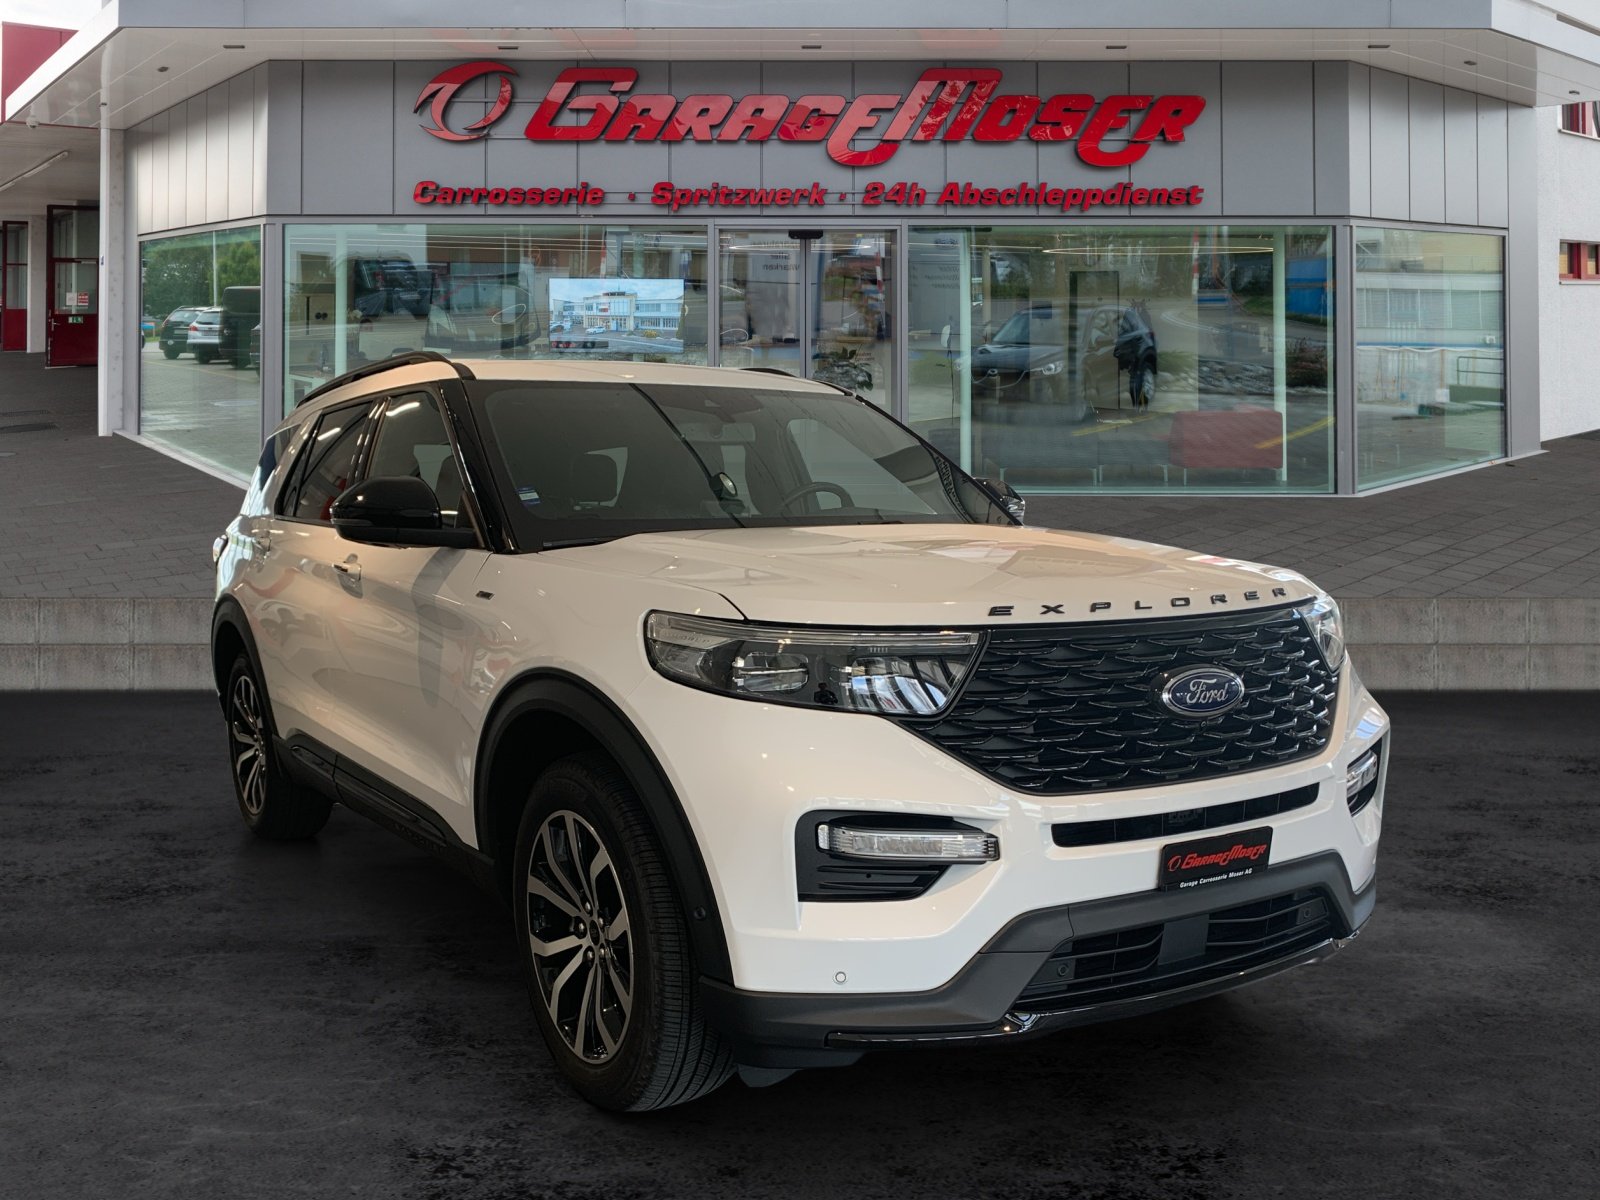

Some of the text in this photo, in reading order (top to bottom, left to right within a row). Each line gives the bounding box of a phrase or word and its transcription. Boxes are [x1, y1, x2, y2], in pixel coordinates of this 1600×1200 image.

[412, 180, 1204, 212] Carrosserie Spritzwerk 24h Abschleppdienst
[988, 587, 1288, 617] EXPLORER
[1186, 678, 1229, 705] Ford
[1180, 880, 1198, 888] Garage
[1199, 874, 1227, 884] Carrosserie
[1228, 870, 1244, 878] Moser
